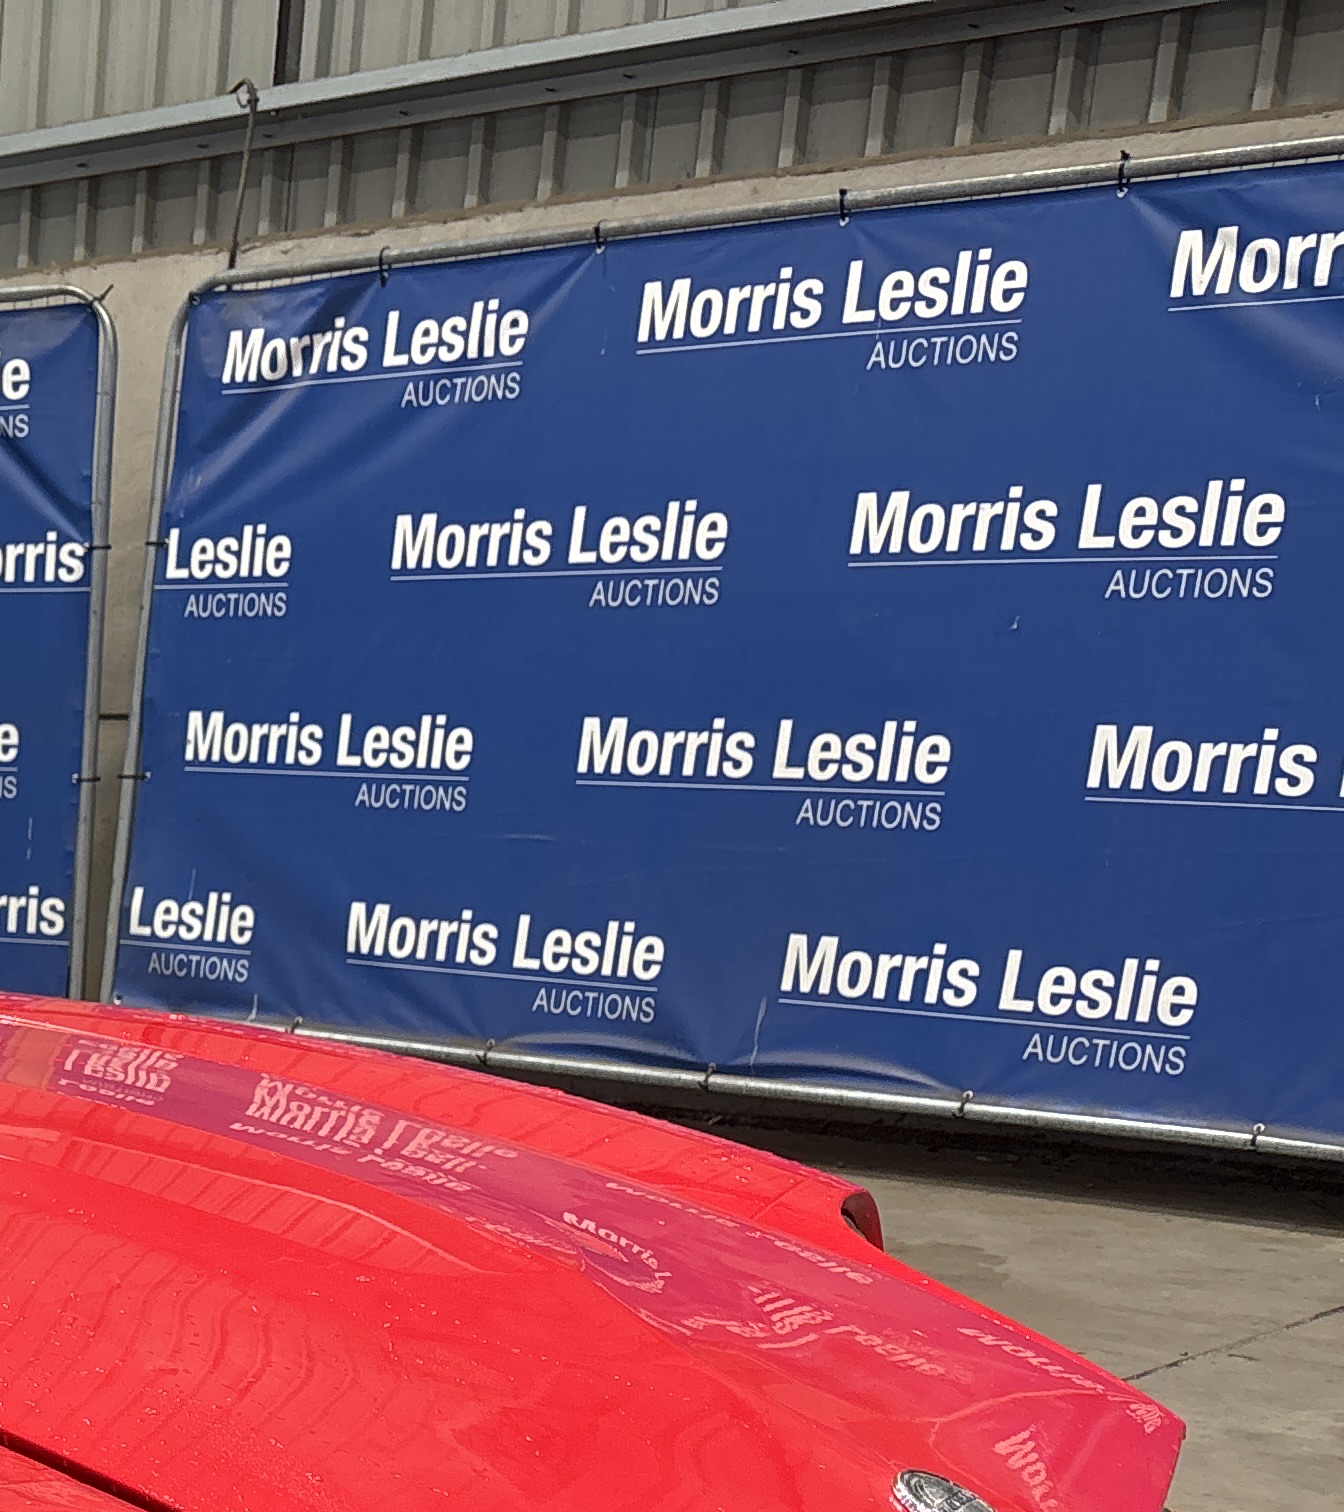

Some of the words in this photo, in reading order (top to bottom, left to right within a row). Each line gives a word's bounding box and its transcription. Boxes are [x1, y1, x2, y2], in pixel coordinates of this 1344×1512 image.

[1170, 226, 1344, 298] Morr
[637, 266, 824, 343] Morris
[841, 247, 1028, 324] Leslie
[221, 316, 369, 384] Morris
[382, 298, 529, 368] Leslie
[866, 331, 1019, 370] AUCTIONS
[401, 371, 521, 408] AUCTIONS
[391, 507, 553, 570] Morris
[567, 499, 728, 564] Leslie
[849, 485, 1058, 555] Morris
[1078, 478, 1286, 549] Leslie
[165, 523, 292, 580] Leslie
[183, 591, 287, 618] AUCTIONS
[588, 577, 720, 608] AUCTIONS
[1104, 567, 1274, 599] AUCTIONS
[184, 710, 324, 766] Morris
[336, 713, 473, 771] Leslie
[576, 716, 756, 779] Morris
[772, 719, 951, 784] Leslie
[1086, 724, 1318, 797] Morris
[354, 782, 467, 812] AUCTIONS
[795, 798, 942, 831] AUCTIONS
[129, 886, 255, 945] Leslie
[346, 901, 499, 966] Morris
[512, 914, 665, 981] Leslie
[147, 952, 250, 983] AUCTIONS
[780, 932, 980, 1008] Morris
[998, 949, 1198, 1027] Leslie
[531, 987, 655, 1023] AUCTIONS
[1022, 1032, 1187, 1075] AUCTIONS
